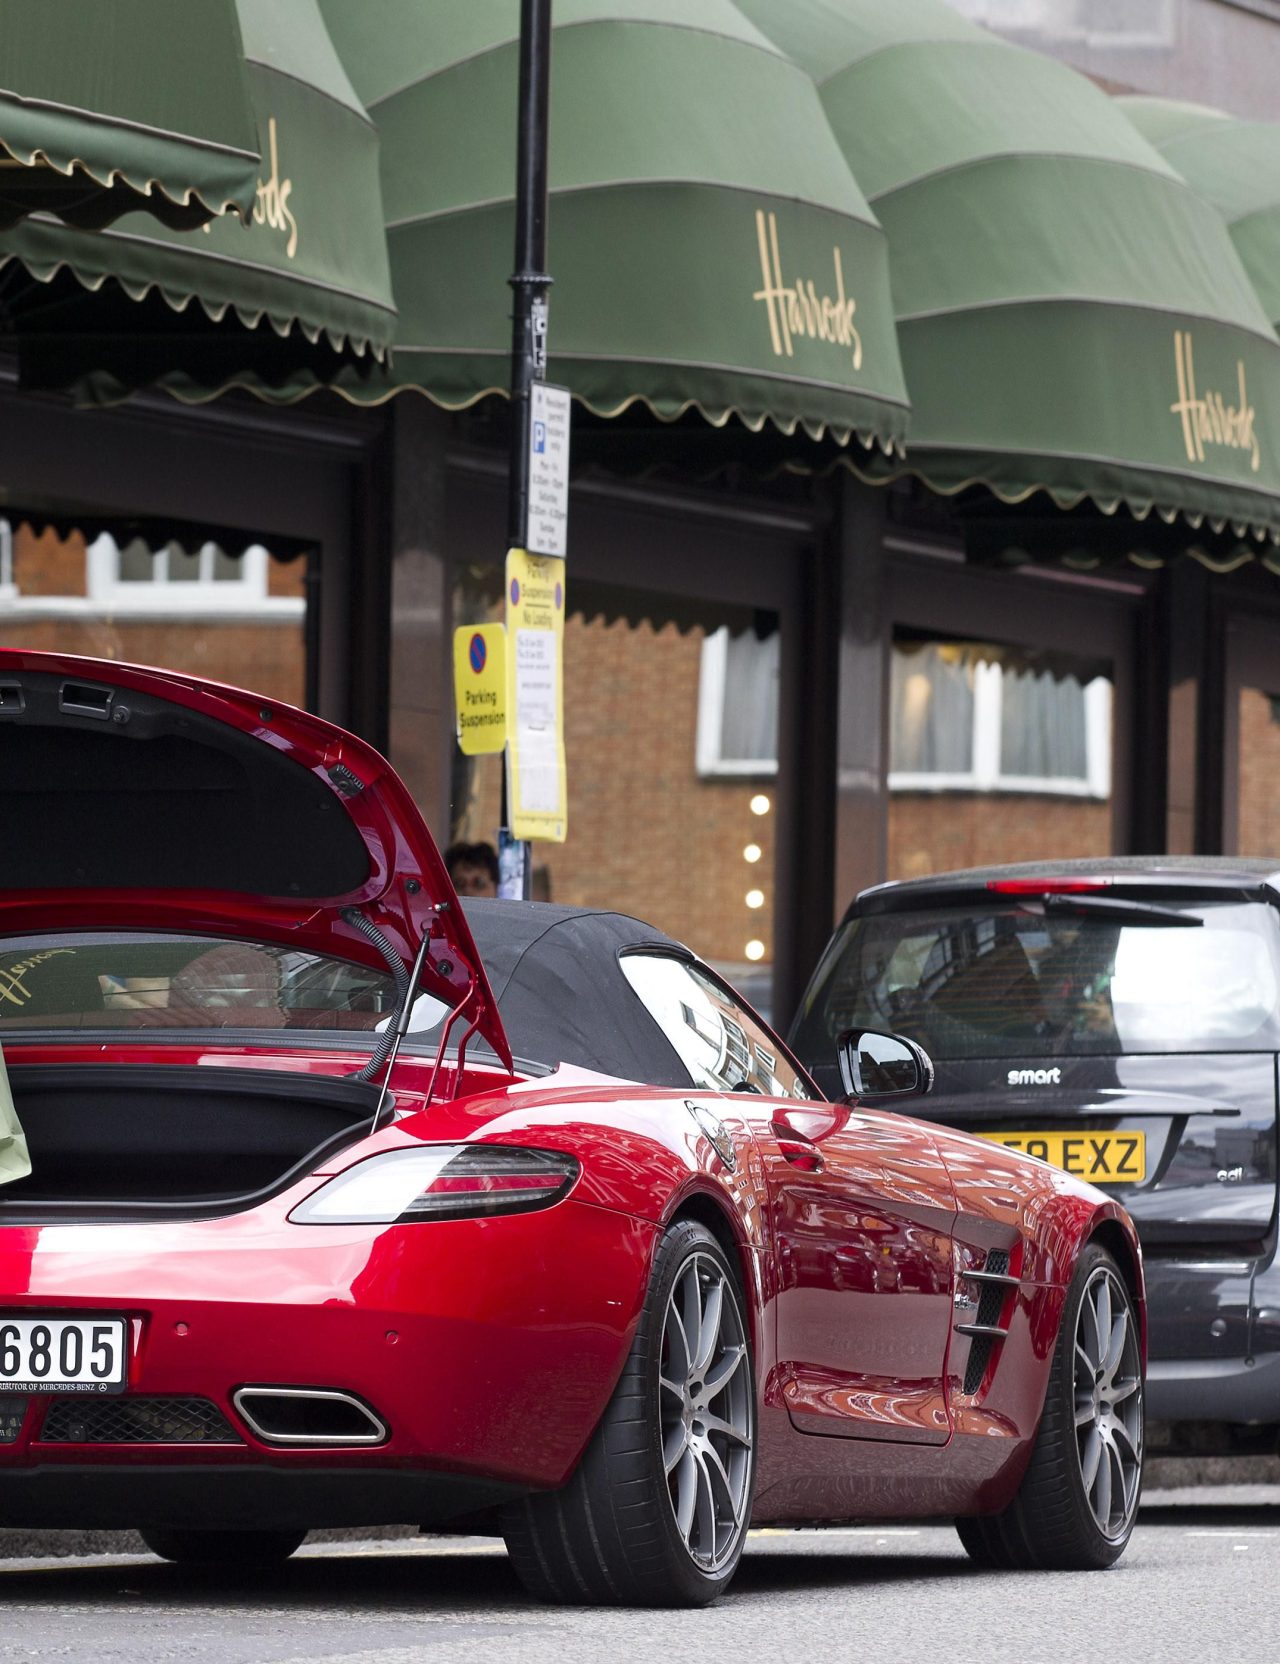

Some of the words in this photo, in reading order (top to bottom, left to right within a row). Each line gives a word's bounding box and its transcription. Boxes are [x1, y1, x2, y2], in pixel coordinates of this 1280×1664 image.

[753, 209, 863, 371] Harrods
[1170, 330, 1261, 472] Harrods
[465, 690, 497, 707] Parking
[460, 711, 505, 728] Suspension
[1007, 1067, 1061, 1085] smart
[1062, 1139, 1138, 1174] EXZ
[28, 1382, 38, 1391] OF
[39, 1382, 95, 1391] MERCEDES-BENZ
